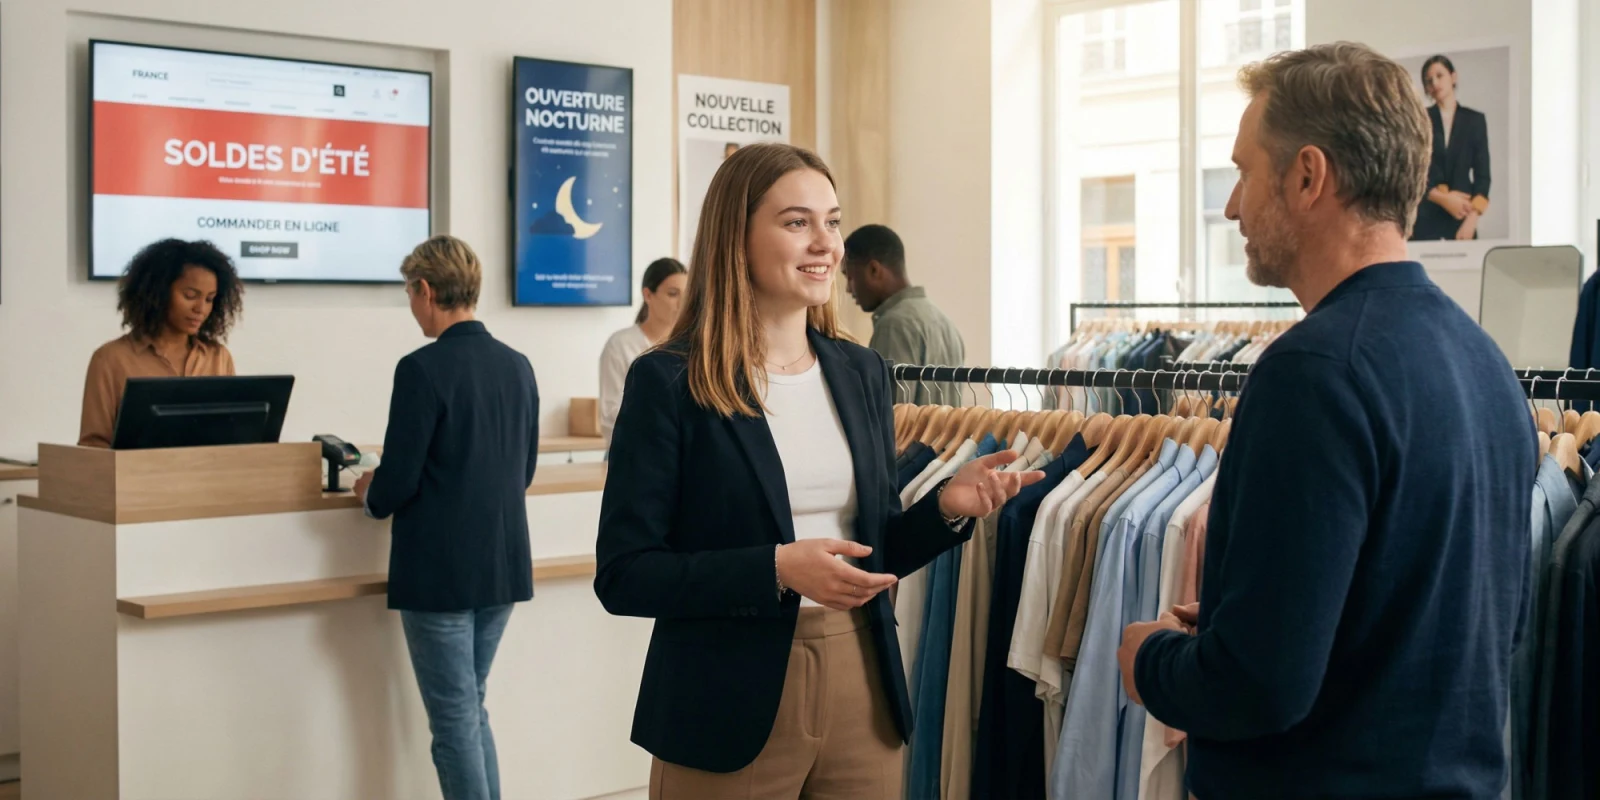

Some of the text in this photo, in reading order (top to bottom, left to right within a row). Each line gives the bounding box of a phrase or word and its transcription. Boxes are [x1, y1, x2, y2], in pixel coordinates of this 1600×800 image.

[132, 69, 169, 81] FRANCE
[525, 87, 625, 112] OUVERTURE
[695, 92, 775, 114] NOUVELLE
[525, 108, 625, 133] NOCTURNE
[687, 112, 782, 135] COLLECTION
[164, 138, 370, 177] SOLDES D'ÉTÉ
[197, 216, 340, 233] COMMANDER EN LIGNE
